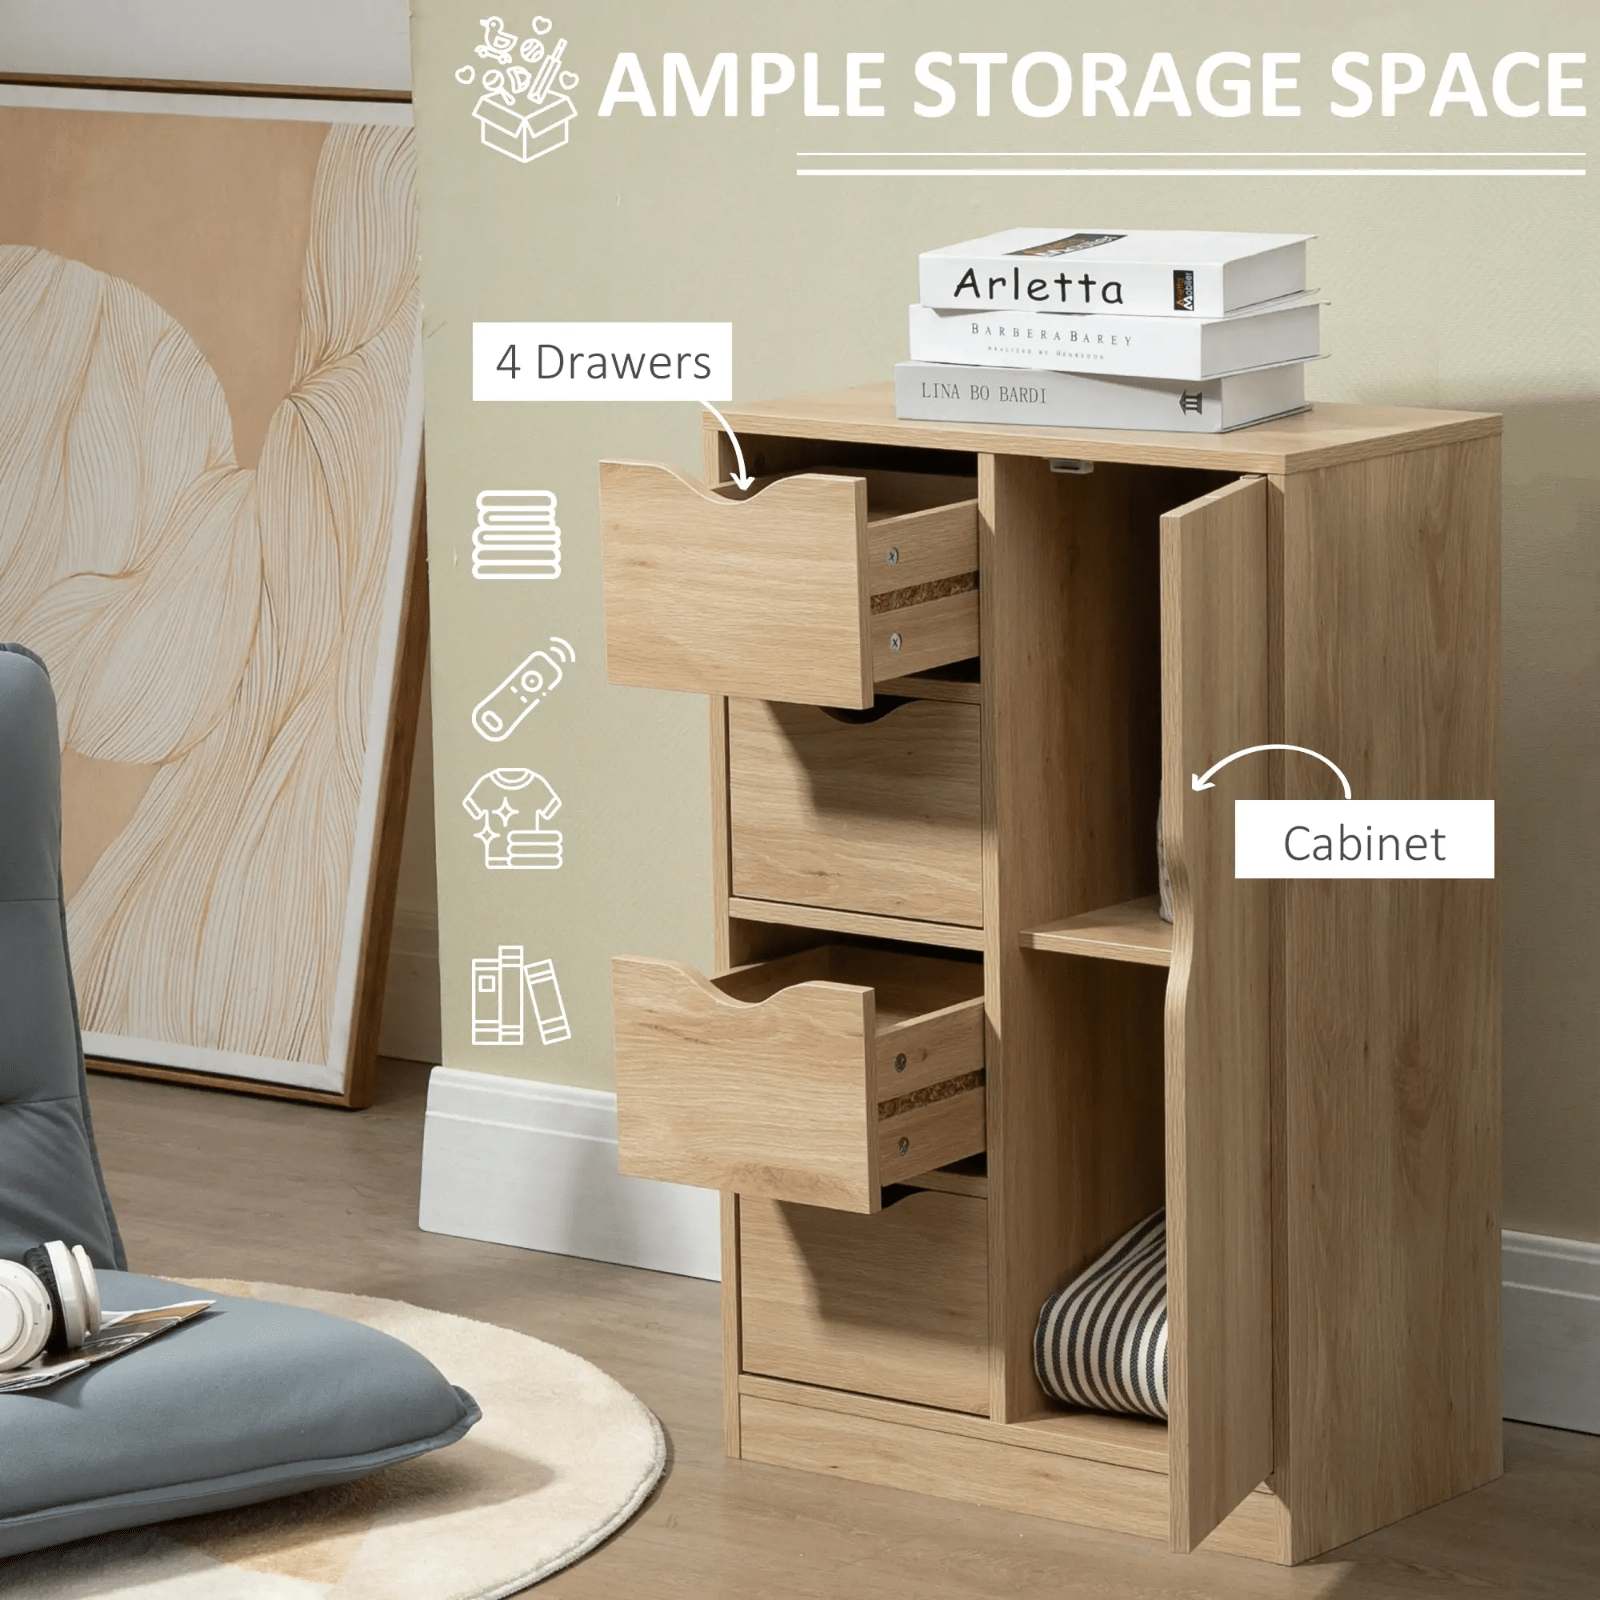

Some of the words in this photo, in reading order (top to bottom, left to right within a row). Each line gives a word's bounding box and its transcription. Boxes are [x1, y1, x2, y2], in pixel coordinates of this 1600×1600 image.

[953, 267, 1124, 305] Arletta
[971, 322, 1061, 341] BARBERA
[1070, 330, 1132, 347] BAREY
[921, 382, 961, 400] LINA
[970, 384, 990, 401] BO
[999, 386, 1047, 404] BARDI
